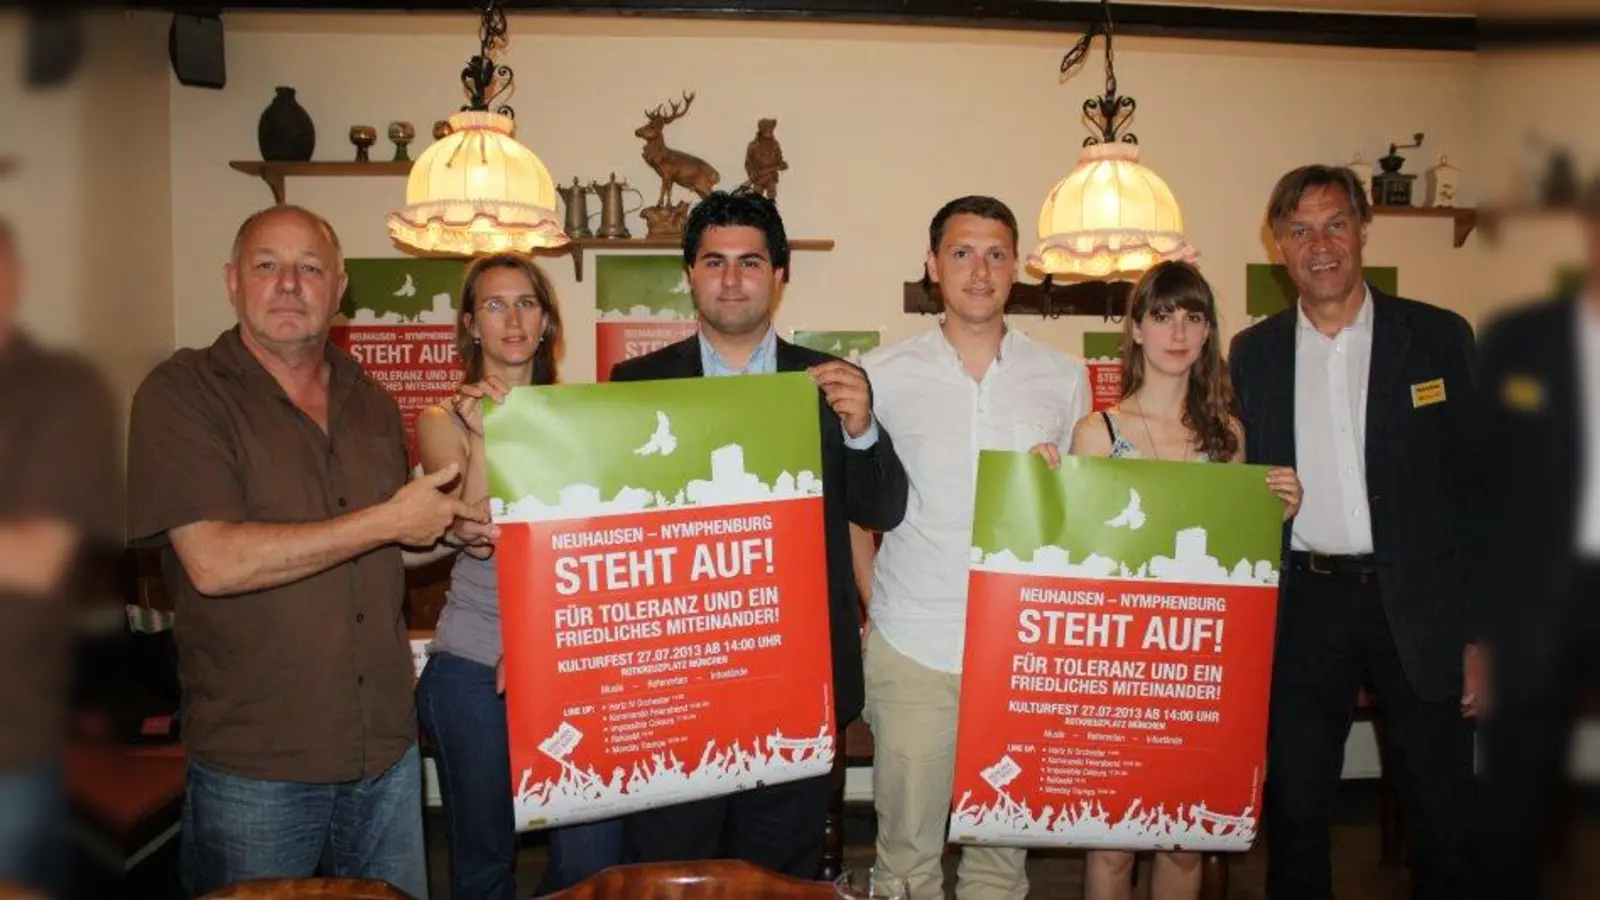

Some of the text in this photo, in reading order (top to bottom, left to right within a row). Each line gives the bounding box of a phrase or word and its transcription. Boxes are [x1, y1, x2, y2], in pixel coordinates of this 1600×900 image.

[350, 344, 413, 364] STEHT
[425, 370, 447, 380] UND
[552, 527, 643, 550] NEUHAUSEN
[661, 515, 773, 541] NYMPHENBURG
[555, 538, 774, 595] STEHT AUF!
[555, 587, 778, 629] FÜR TOLERANZ UND EIN
[1020, 588, 1104, 606] NEUHAUSEN
[1120, 593, 1226, 612] NYMPHENBURG
[556, 609, 780, 648] FRIEDLICHES MITEINANDER!
[1018, 609, 1224, 654] STEHT AUF!
[558, 635, 782, 673] KULTURFEST 27.07.2013 AB 14:00 UHR
[1013, 652, 1222, 682] FÜR TOLERANZ UND EIN
[1010, 675, 1221, 700] FRIEDLICHES MITEINANDER!
[1008, 700, 1220, 723] KULTURFEST 27.07.2013 AB 14:00 UHR
